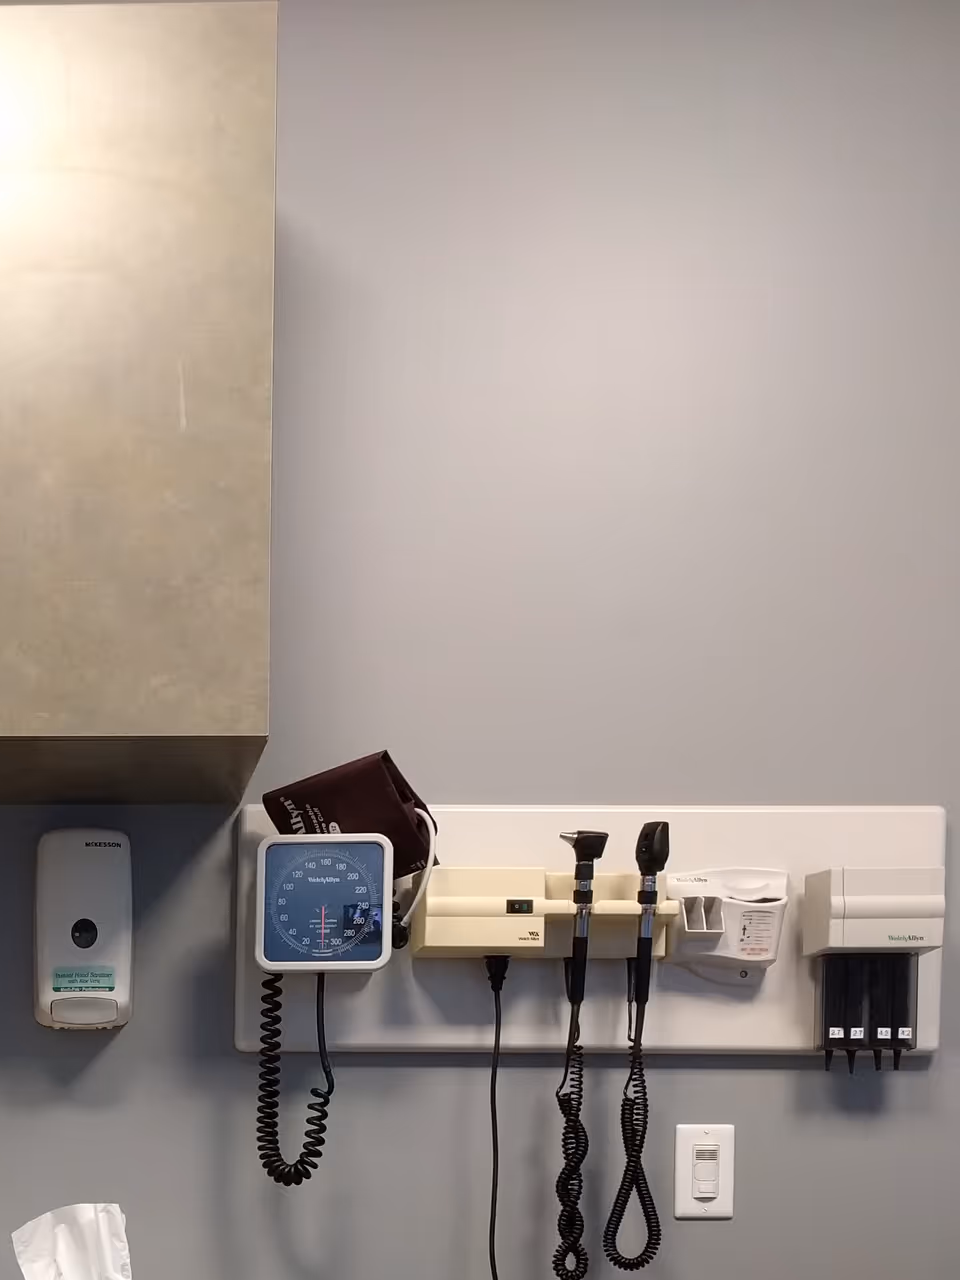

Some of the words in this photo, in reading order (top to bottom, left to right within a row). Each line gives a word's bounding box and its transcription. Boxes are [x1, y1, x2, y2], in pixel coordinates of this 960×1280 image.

[320, 858, 332, 866] 160
[335, 863, 347, 871] 180
[355, 886, 367, 894] 220
[277, 898, 286, 906] 80
[357, 902, 369, 910] 240
[353, 917, 365, 925] 260
[288, 928, 297, 936] 40
[343, 929, 356, 937] 280
[301, 937, 310, 945] 20
[330, 938, 342, 946] 300
